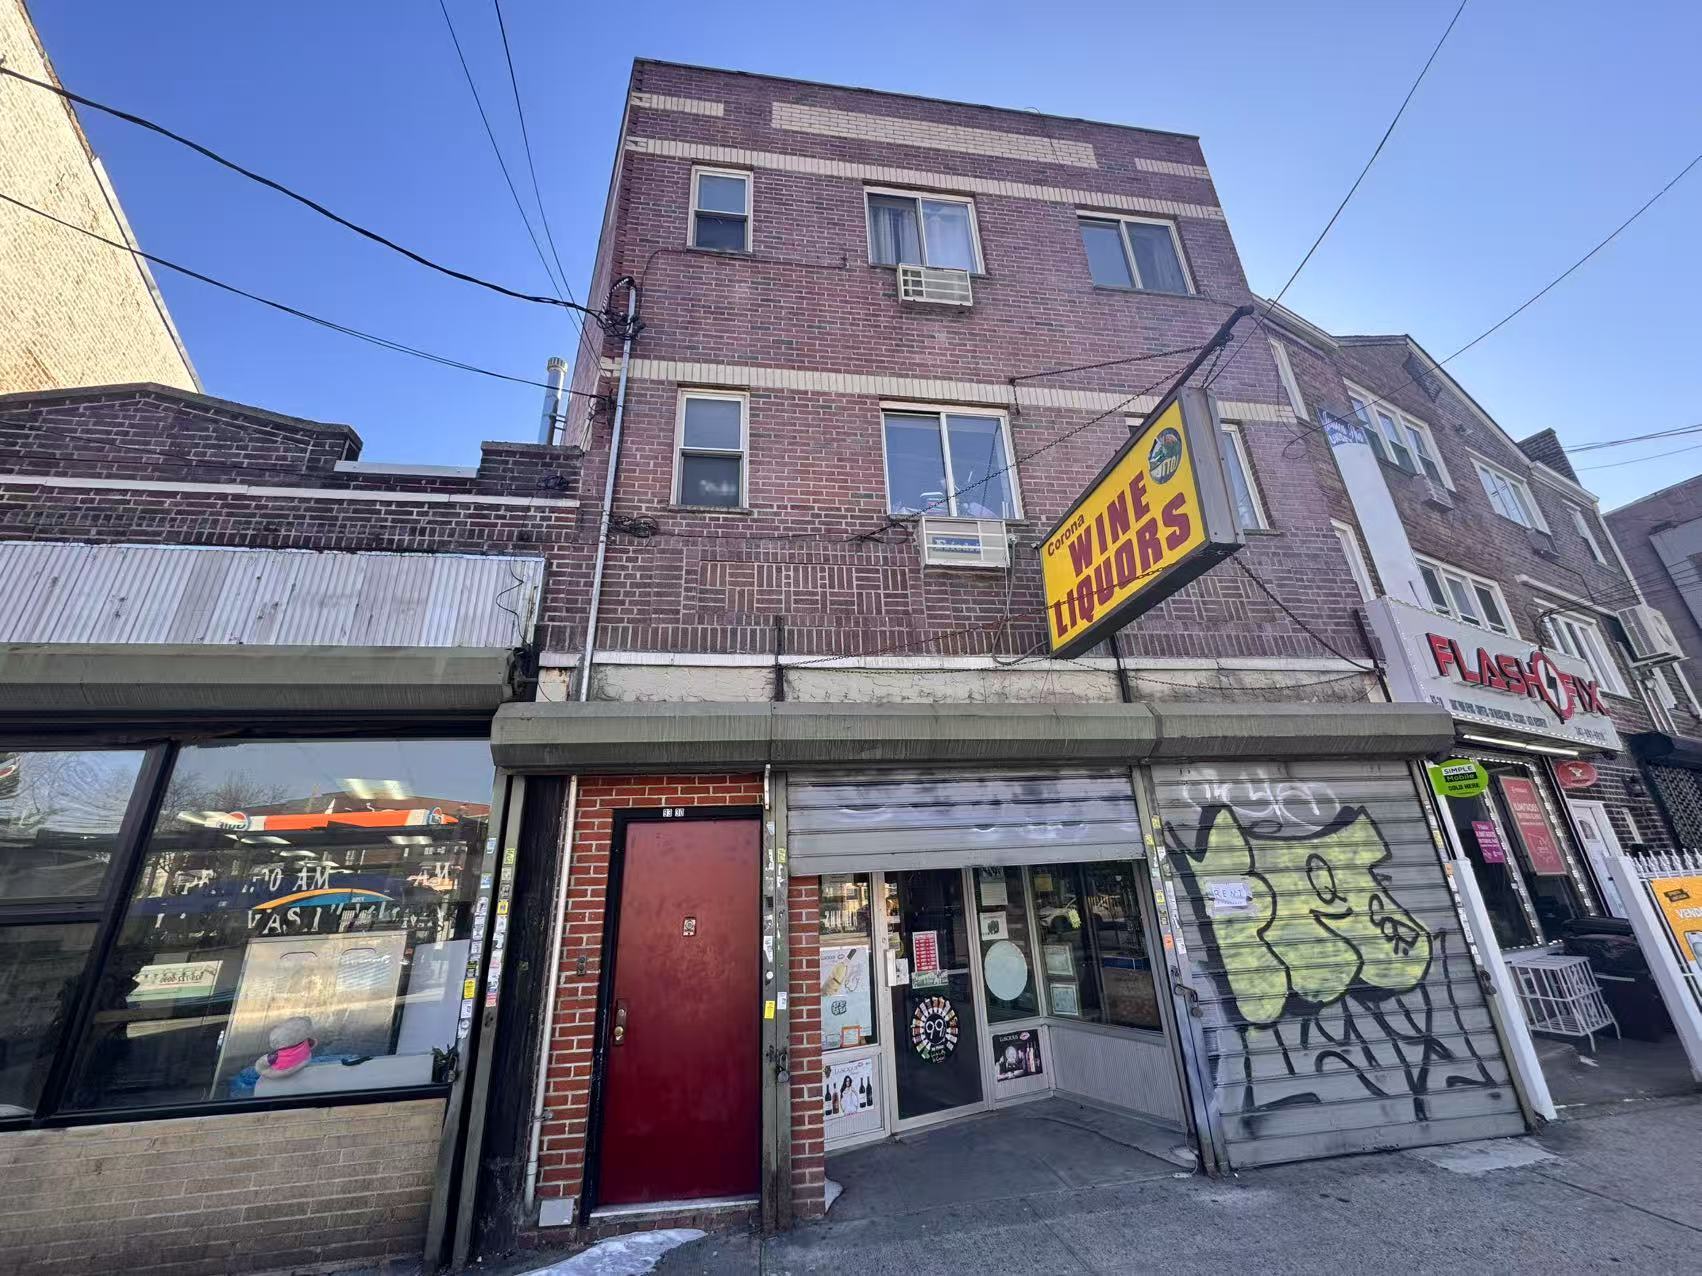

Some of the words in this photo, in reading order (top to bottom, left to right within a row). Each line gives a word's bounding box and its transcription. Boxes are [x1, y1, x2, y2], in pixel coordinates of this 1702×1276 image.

[1047, 513, 1085, 557] Corona
[1068, 470, 1151, 578] WINE
[1053, 491, 1191, 639] LIQUORS
[1426, 632, 1541, 699] FLASH
[1444, 766, 1472, 775] SIMPLE
[1447, 773, 1474, 781] Mobile
[925, 1018, 944, 1039] 99
